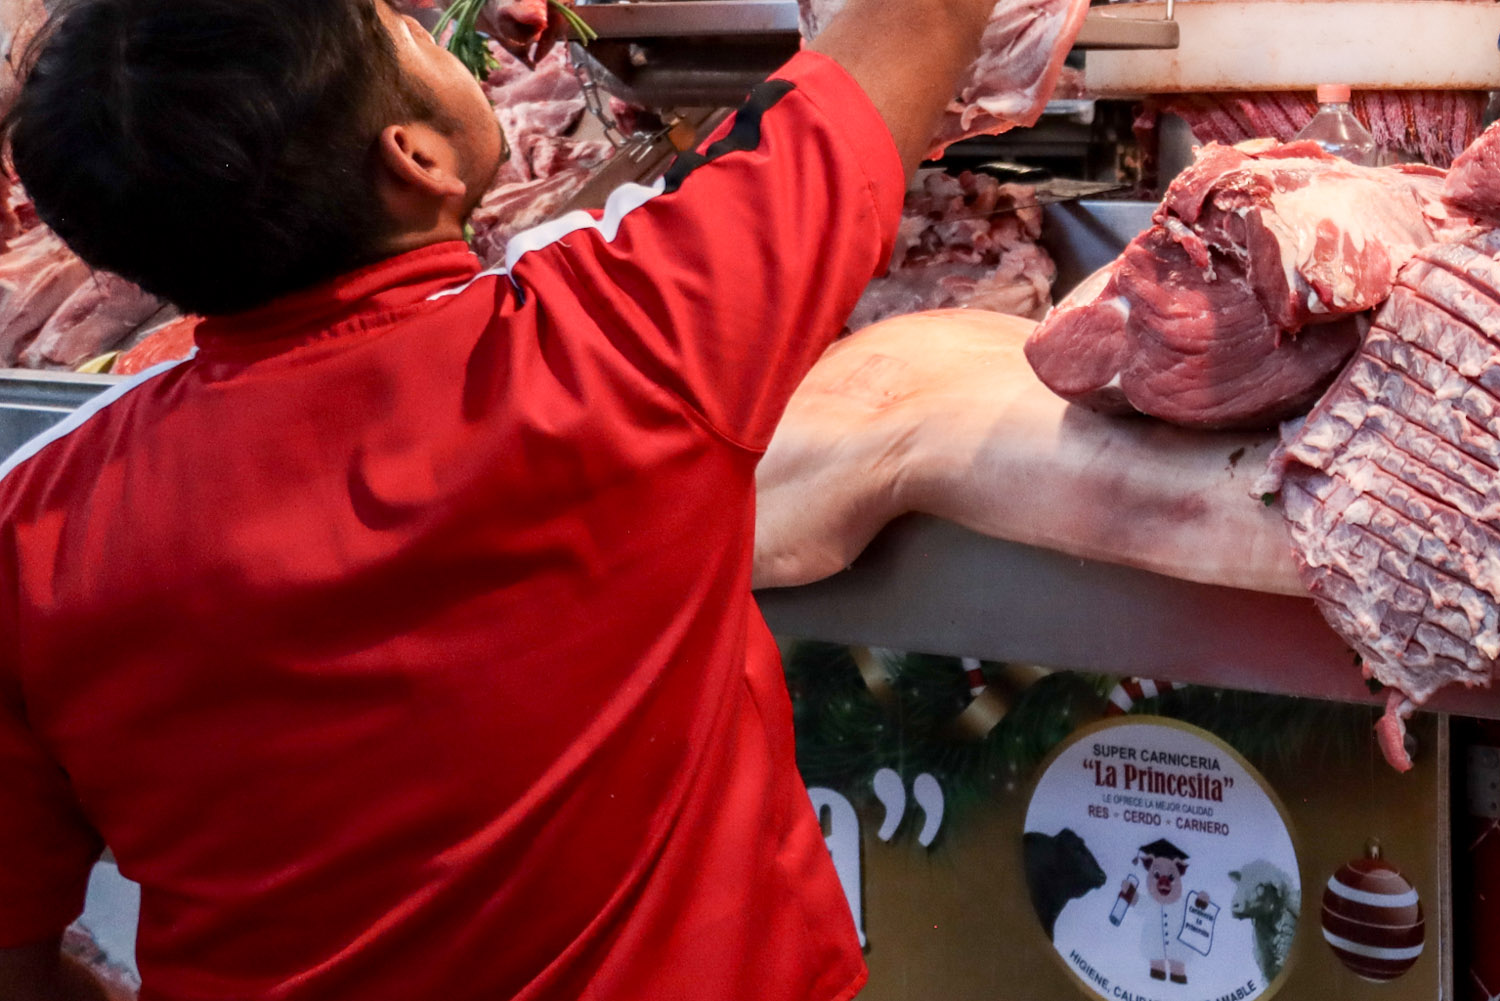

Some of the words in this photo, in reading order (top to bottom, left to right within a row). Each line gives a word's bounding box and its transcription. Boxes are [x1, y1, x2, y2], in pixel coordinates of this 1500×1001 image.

[1093, 743, 1136, 760] SUPER
[1140, 749, 1221, 771] CARNICERIA
[1123, 763, 1234, 802] Princesita”
[1102, 794, 1112, 804] LE
[1113, 795, 1143, 808] OFRECE
[1144, 799, 1154, 808] LA
[1155, 800, 1181, 813] MEJOR
[1182, 804, 1214, 817] CALIDAD
[1088, 805, 1109, 819] RES
[1123, 809, 1161, 826] CERDO
[1175, 817, 1230, 836] CARNERO
